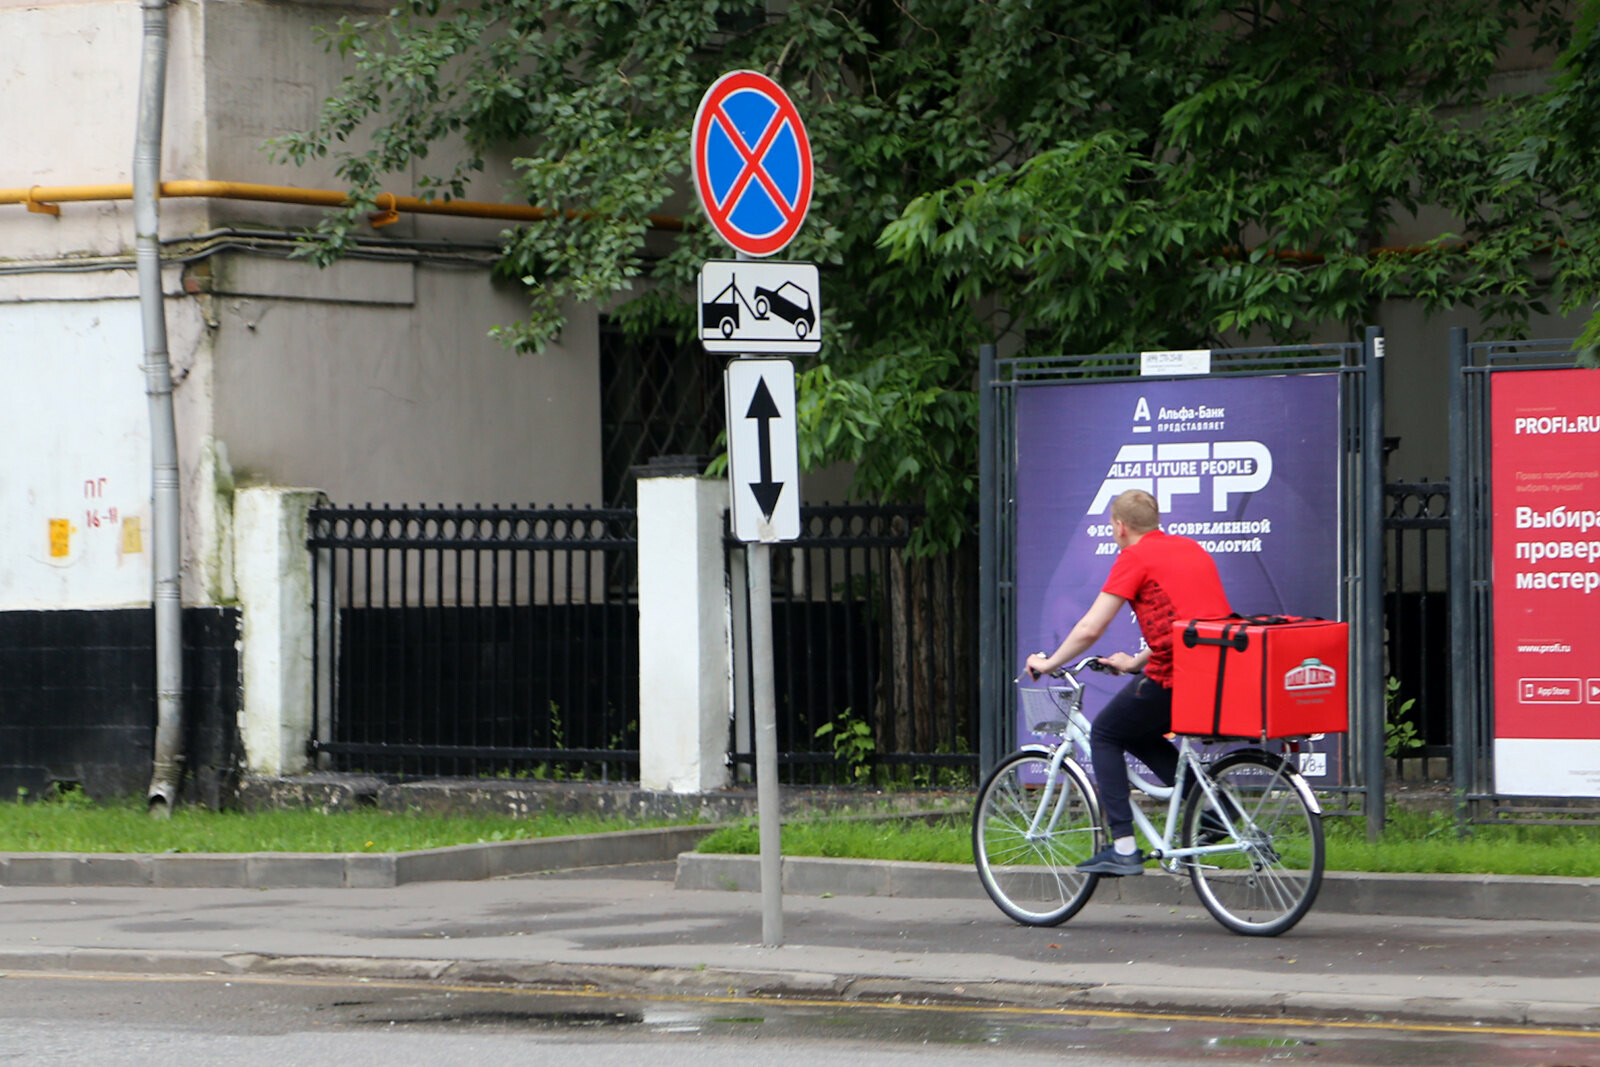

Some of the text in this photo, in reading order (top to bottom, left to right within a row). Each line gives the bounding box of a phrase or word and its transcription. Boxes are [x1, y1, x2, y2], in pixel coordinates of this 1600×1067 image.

[1158, 406, 1225, 421] Альфа-Банк
[1157, 421, 1225, 432] ПРЕДСТАВЛЯЕТ
[1107, 460, 1252, 478] ALFA FUTURE PEOPLE
[1168, 519, 1271, 535] СОВРЕМЕННОЙ
[1198, 537, 1262, 553] НОЛОГИЙ
[1516, 571, 1600, 594] мастер
[1517, 643, 1571, 654] www.profi.ru
[1302, 758, 1325, 772] 18+
